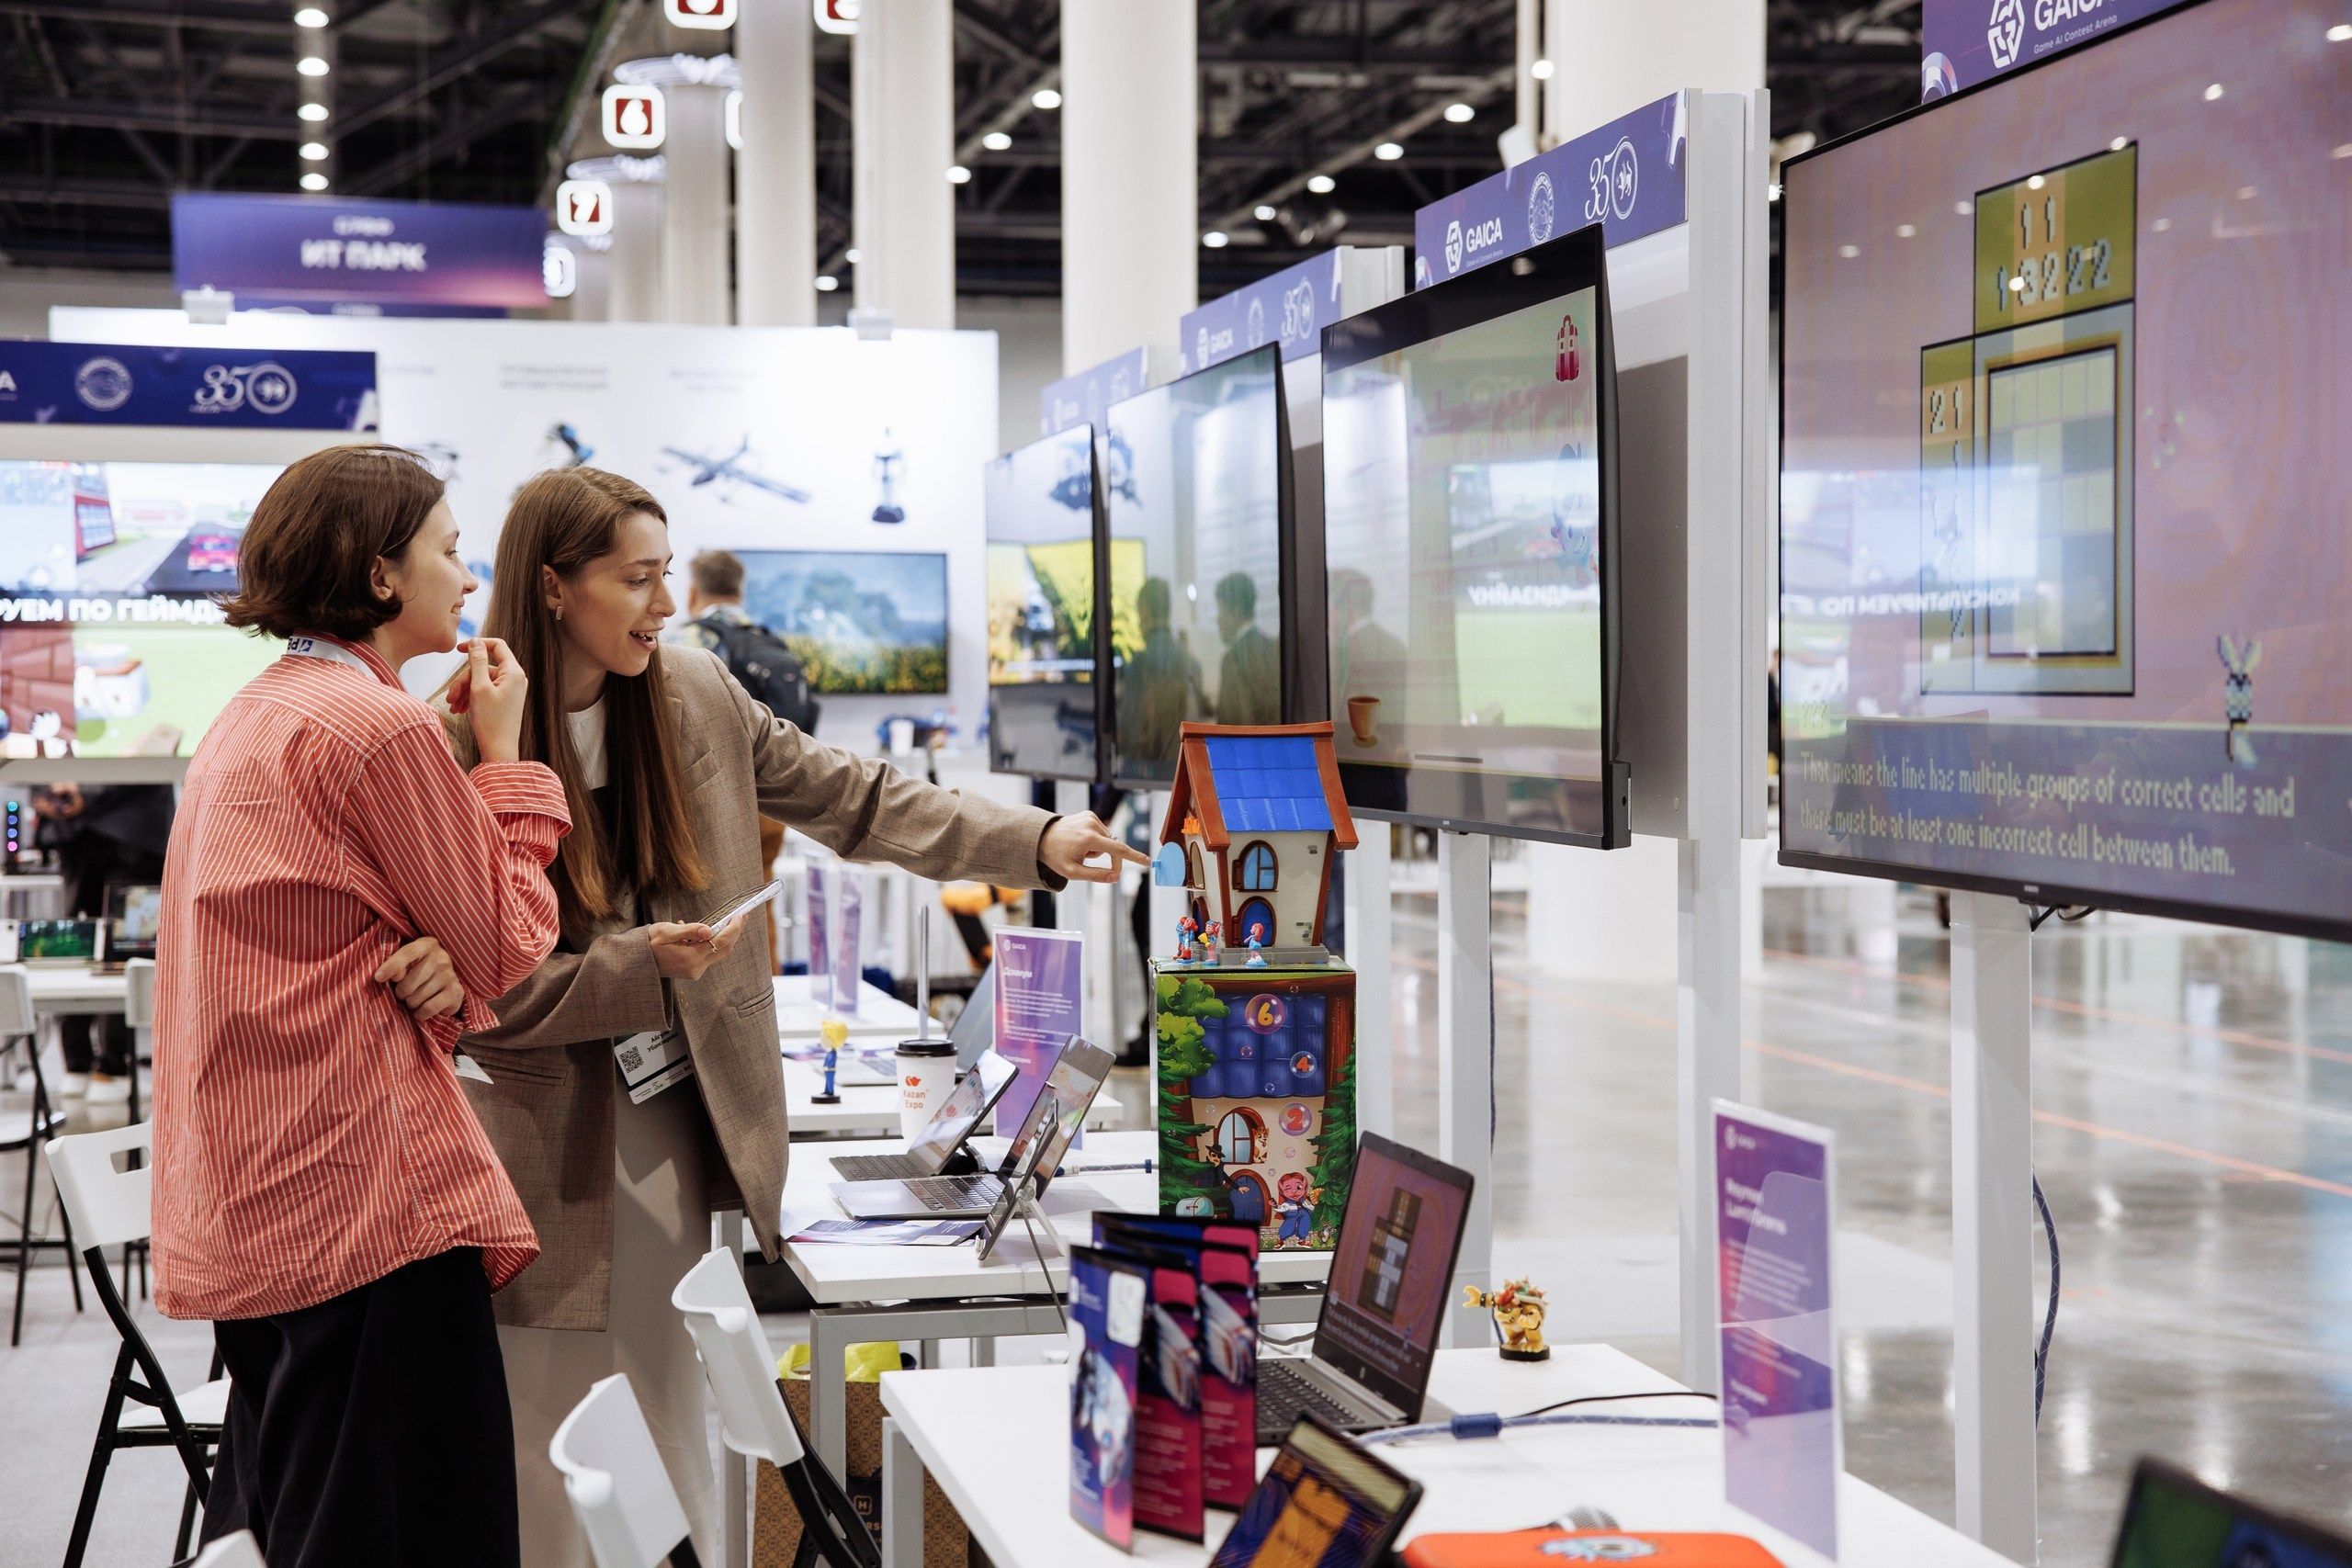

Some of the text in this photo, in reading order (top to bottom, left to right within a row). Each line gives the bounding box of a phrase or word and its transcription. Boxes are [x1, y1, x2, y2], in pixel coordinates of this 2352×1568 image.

[2034, 0, 2110, 30] GAI
[2034, 15, 2118, 54] Game AI Contest Arena
[1466, 218, 1503, 254] GAICA
[0, 597, 64, 623] УЕМ
[69, 599, 113, 622] ПО
[1801, 751, 2295, 818] That means the line has multiple groups of correct cells and
[1801, 799, 2235, 876] there must be at least one incorrect cell between them.
[1258, 1002, 1273, 1026] 6
[1296, 1056, 1313, 1073] 4
[905, 1100, 923, 1110] Expo
[1286, 1107, 1303, 1131] 2
